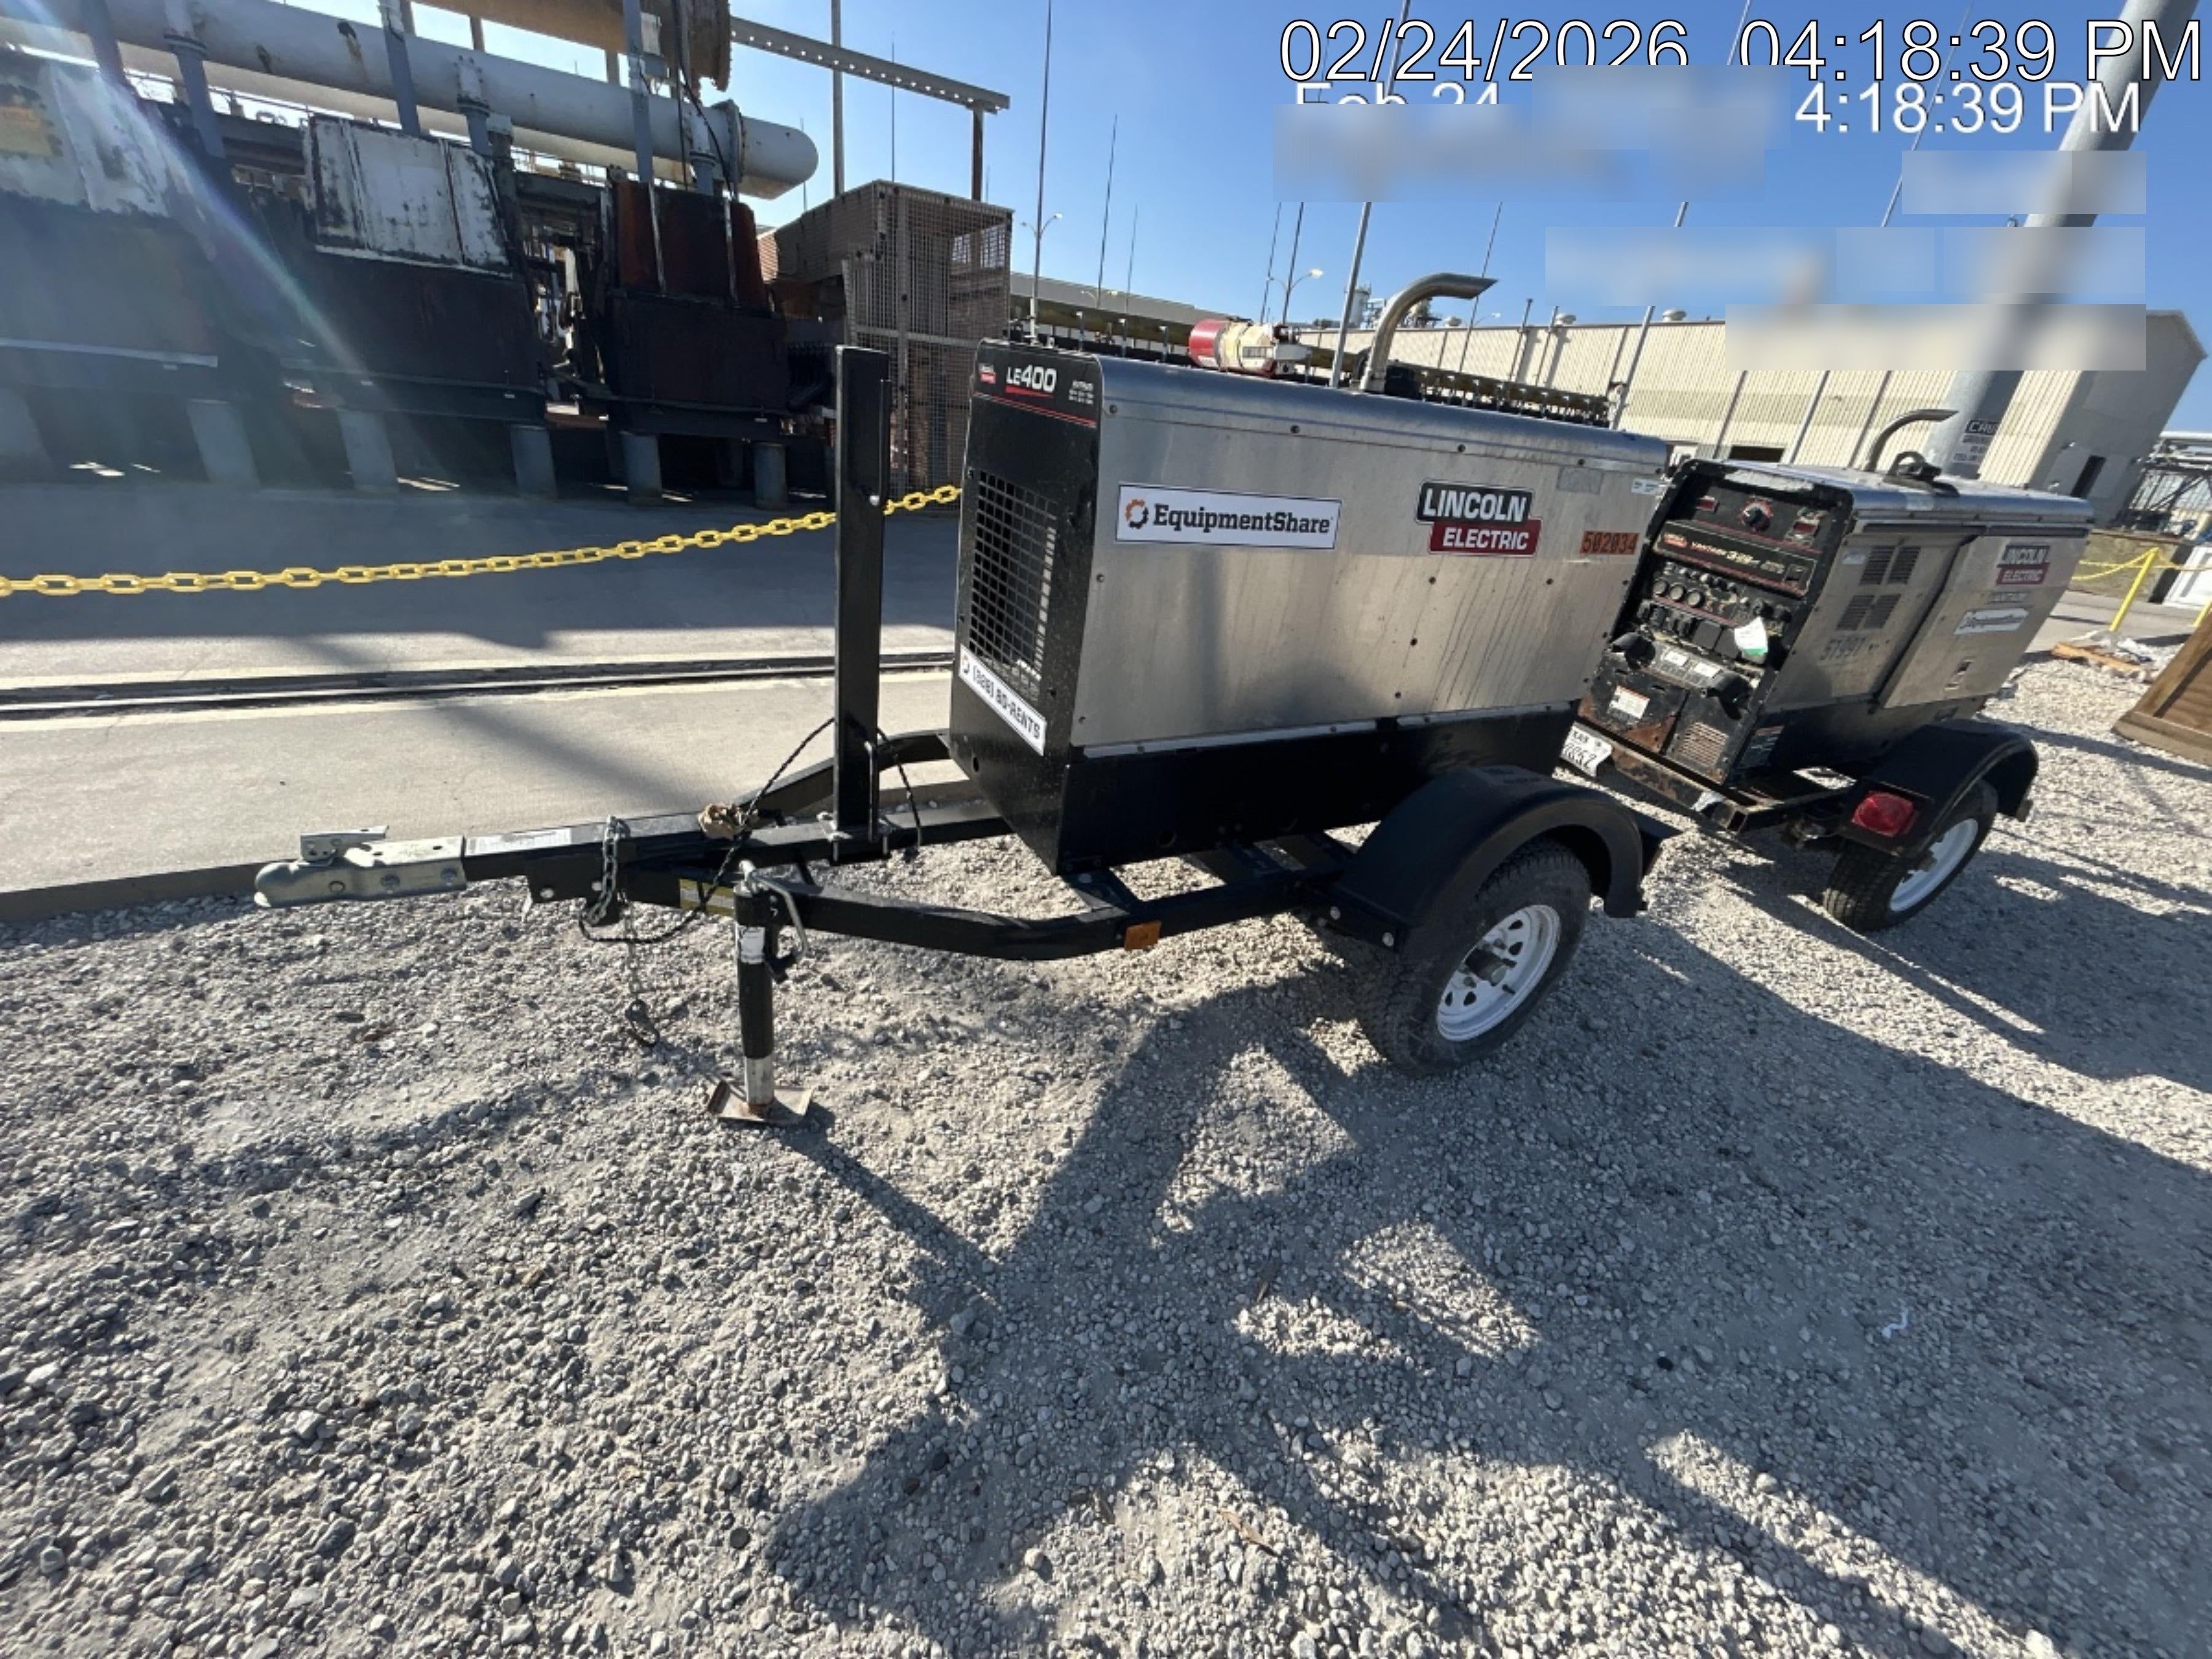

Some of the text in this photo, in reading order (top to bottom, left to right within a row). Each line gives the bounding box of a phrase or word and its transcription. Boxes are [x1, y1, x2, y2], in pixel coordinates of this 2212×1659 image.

[1006, 364, 1057, 393] LE400
[1153, 503, 1331, 533] EquipmentShare
[1422, 488, 1527, 522] LINCOLN
[1443, 527, 1529, 551] ELECTRIC
